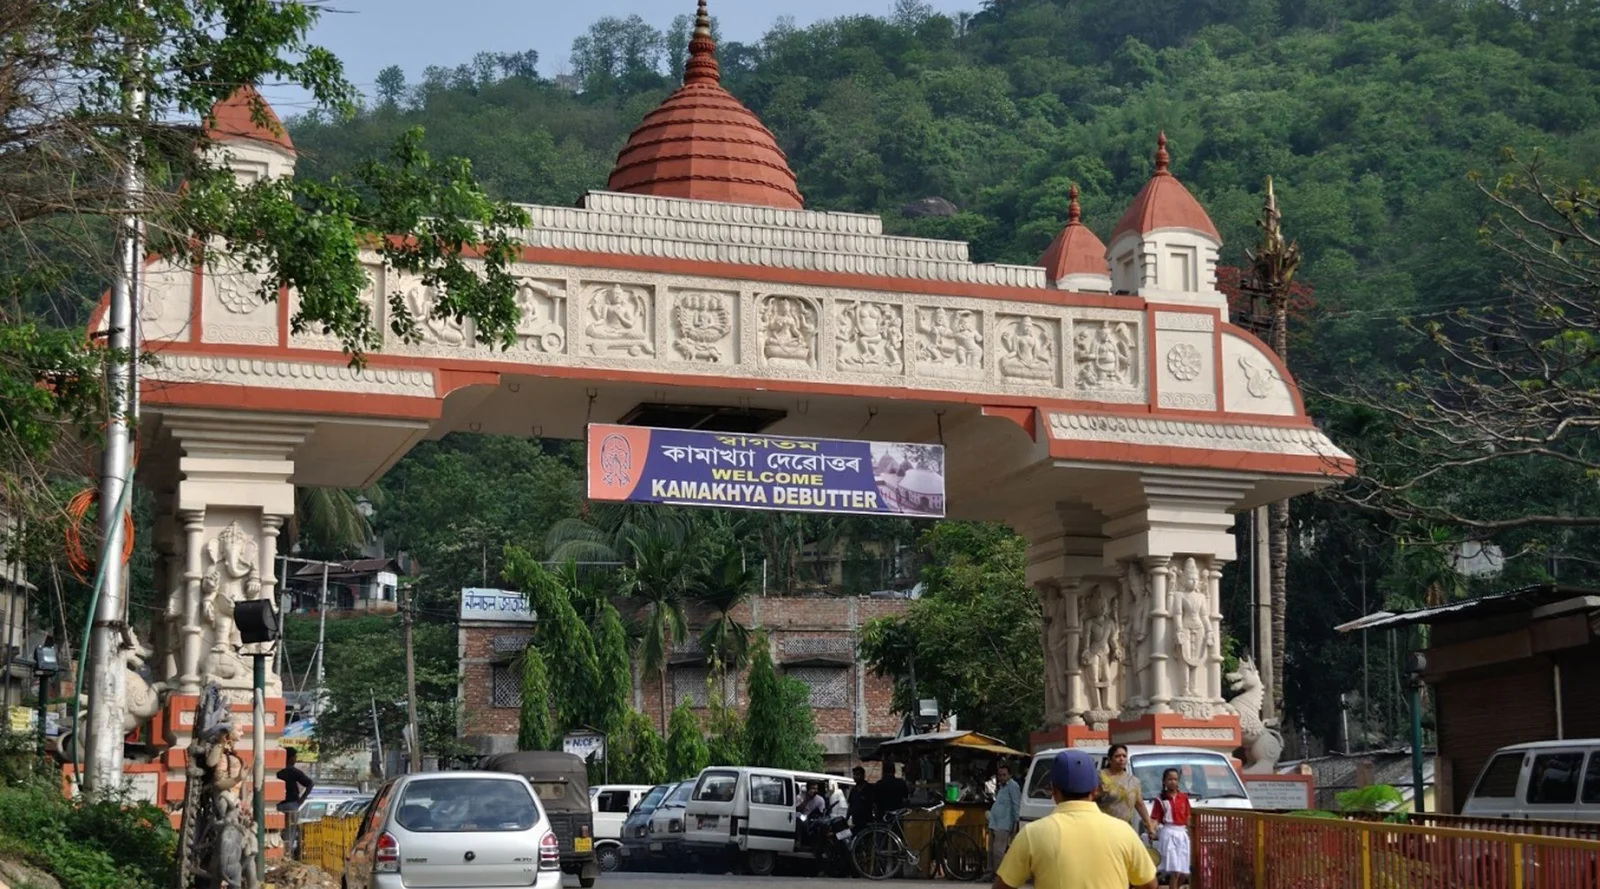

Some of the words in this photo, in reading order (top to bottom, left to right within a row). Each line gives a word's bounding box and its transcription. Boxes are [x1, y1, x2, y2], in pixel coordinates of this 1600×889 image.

[714, 435, 819, 452] স্বাগতম
[661, 445, 756, 468] কামাখ্যা
[712, 468, 824, 486] WELCOME
[652, 479, 768, 504] KAMAKHYA
[773, 486, 878, 509] DEBUTTER
